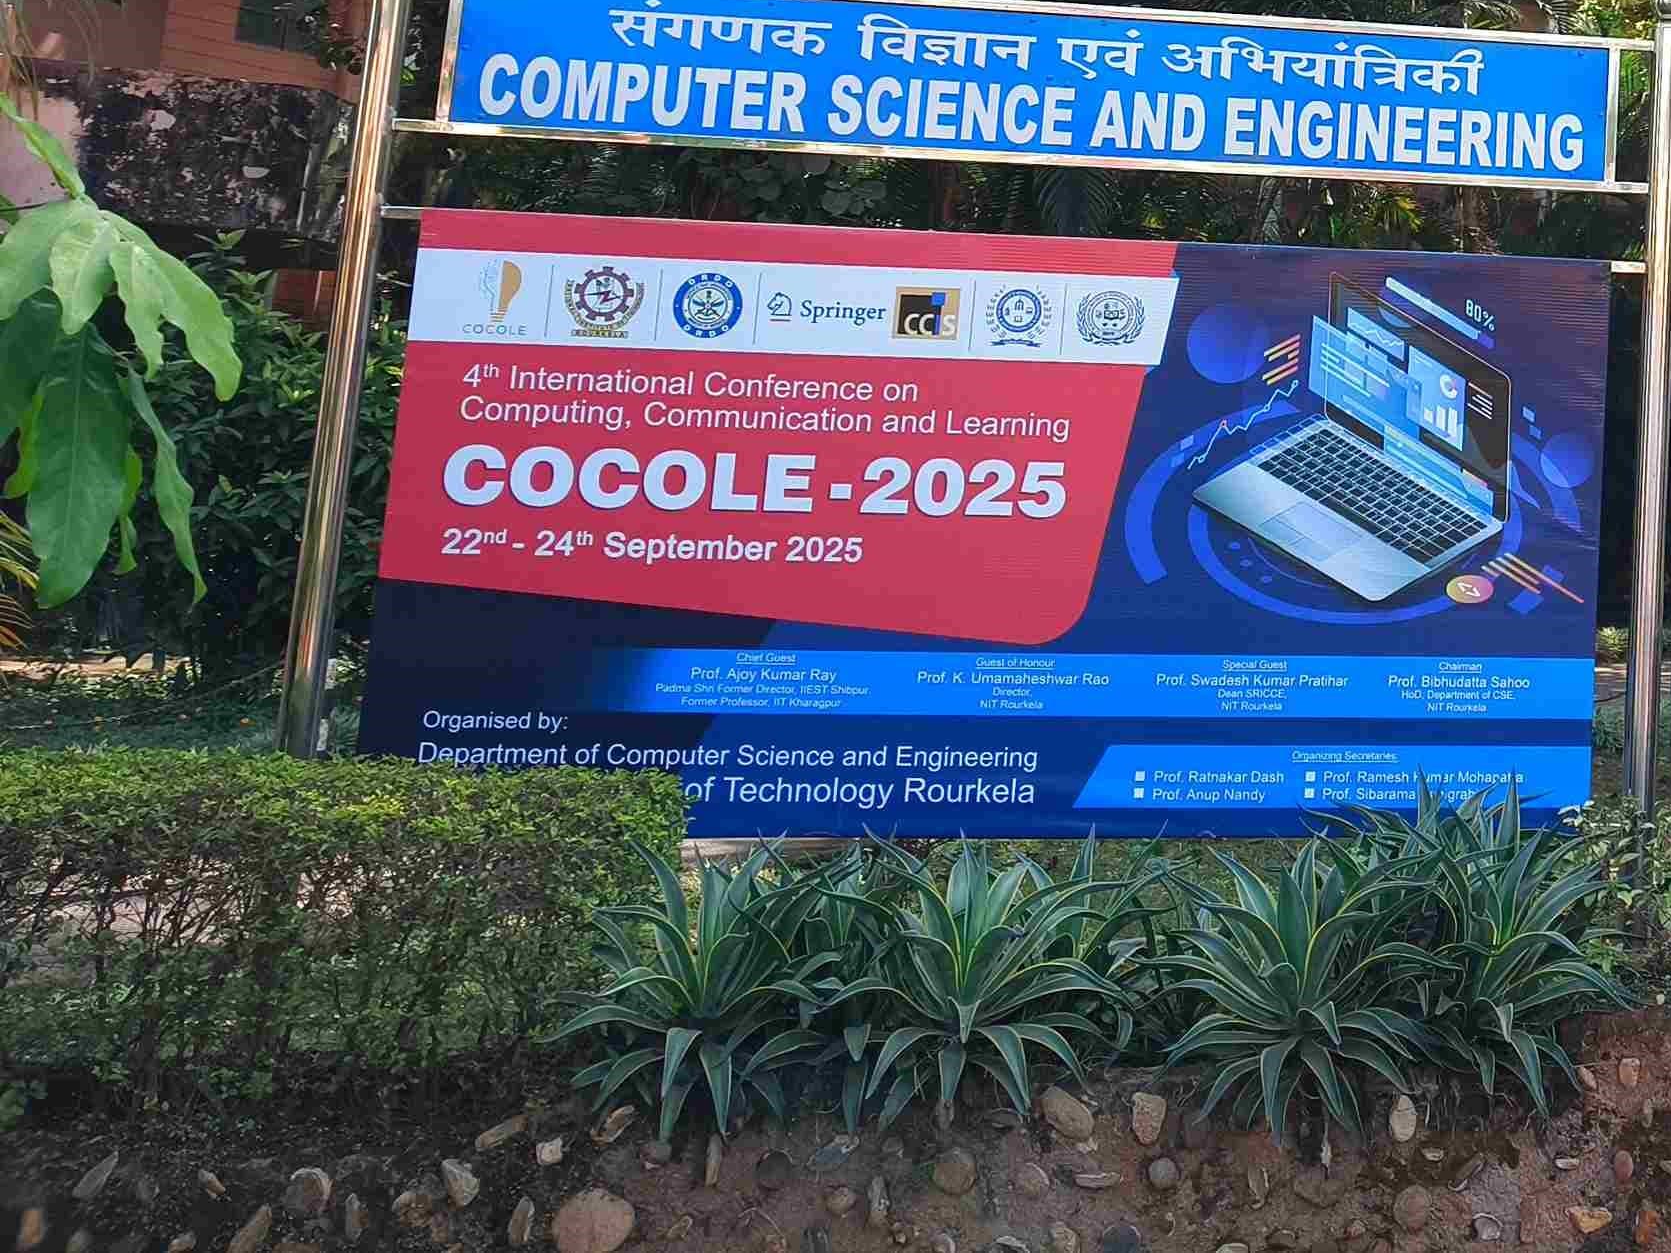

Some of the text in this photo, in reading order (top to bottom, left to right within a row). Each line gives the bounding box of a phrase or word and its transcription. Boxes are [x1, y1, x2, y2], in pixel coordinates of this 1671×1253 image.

[610, 0, 1485, 94] संगणक विज्ञान एवं अभियांत्रिकी
[479, 54, 1583, 171] COMPUTER SCIENCE AND ENGINEERING
[800, 299, 887, 325] Springer
[1465, 298, 1495, 332] 80%
[462, 323, 527, 336] COCOLE
[463, 364, 917, 401] 4th International Conference on
[461, 396, 1069, 442] Computing, Communication and Learning
[444, 445, 816, 512] COCOLE
[442, 528, 507, 554] 22nd
[535, 530, 593, 556] 24th
[604, 532, 777, 564] September
[785, 536, 862, 562] 2025
[765, 653, 796, 663] Guest
[976, 657, 1056, 668] Guest of Honour
[1223, 660, 1287, 671] Special Guest
[1439, 662, 1482, 673] Chairman
[691, 667, 836, 683] Prof. Ajoy Kumar Ray
[918, 671, 946, 683] Prof.
[1083, 673, 1109, 685] Rao
[1157, 674, 1348, 687] Prof. Swadesh Kumar Pratihar
[1389, 675, 1530, 688] Prof. Bibhudatta Sahoo
[1218, 689, 1243, 700] Dean
[1427, 690, 1479, 700] Department
[1482, 691, 1491, 699] of
[980, 699, 998, 707] NIT
[1221, 701, 1239, 711] NIT
[1427, 702, 1444, 711] NIT
[424, 711, 568, 733] Organised by:
[417, 742, 1037, 773] Department of Computer Science and Engineering
[1292, 751, 1346, 763] Organizing
[1154, 771, 1284, 783] Prof. Ratnakar Dash
[1324, 771, 1352, 783] Prof.
[1357, 771, 1409, 783] Ramesh
[685, 776, 1034, 809] of Technology Rourkela
[1153, 788, 1265, 803] Prof. Anup Nandy
[1323, 788, 1349, 800] Prof.
[1356, 788, 1416, 800] Sibarama
